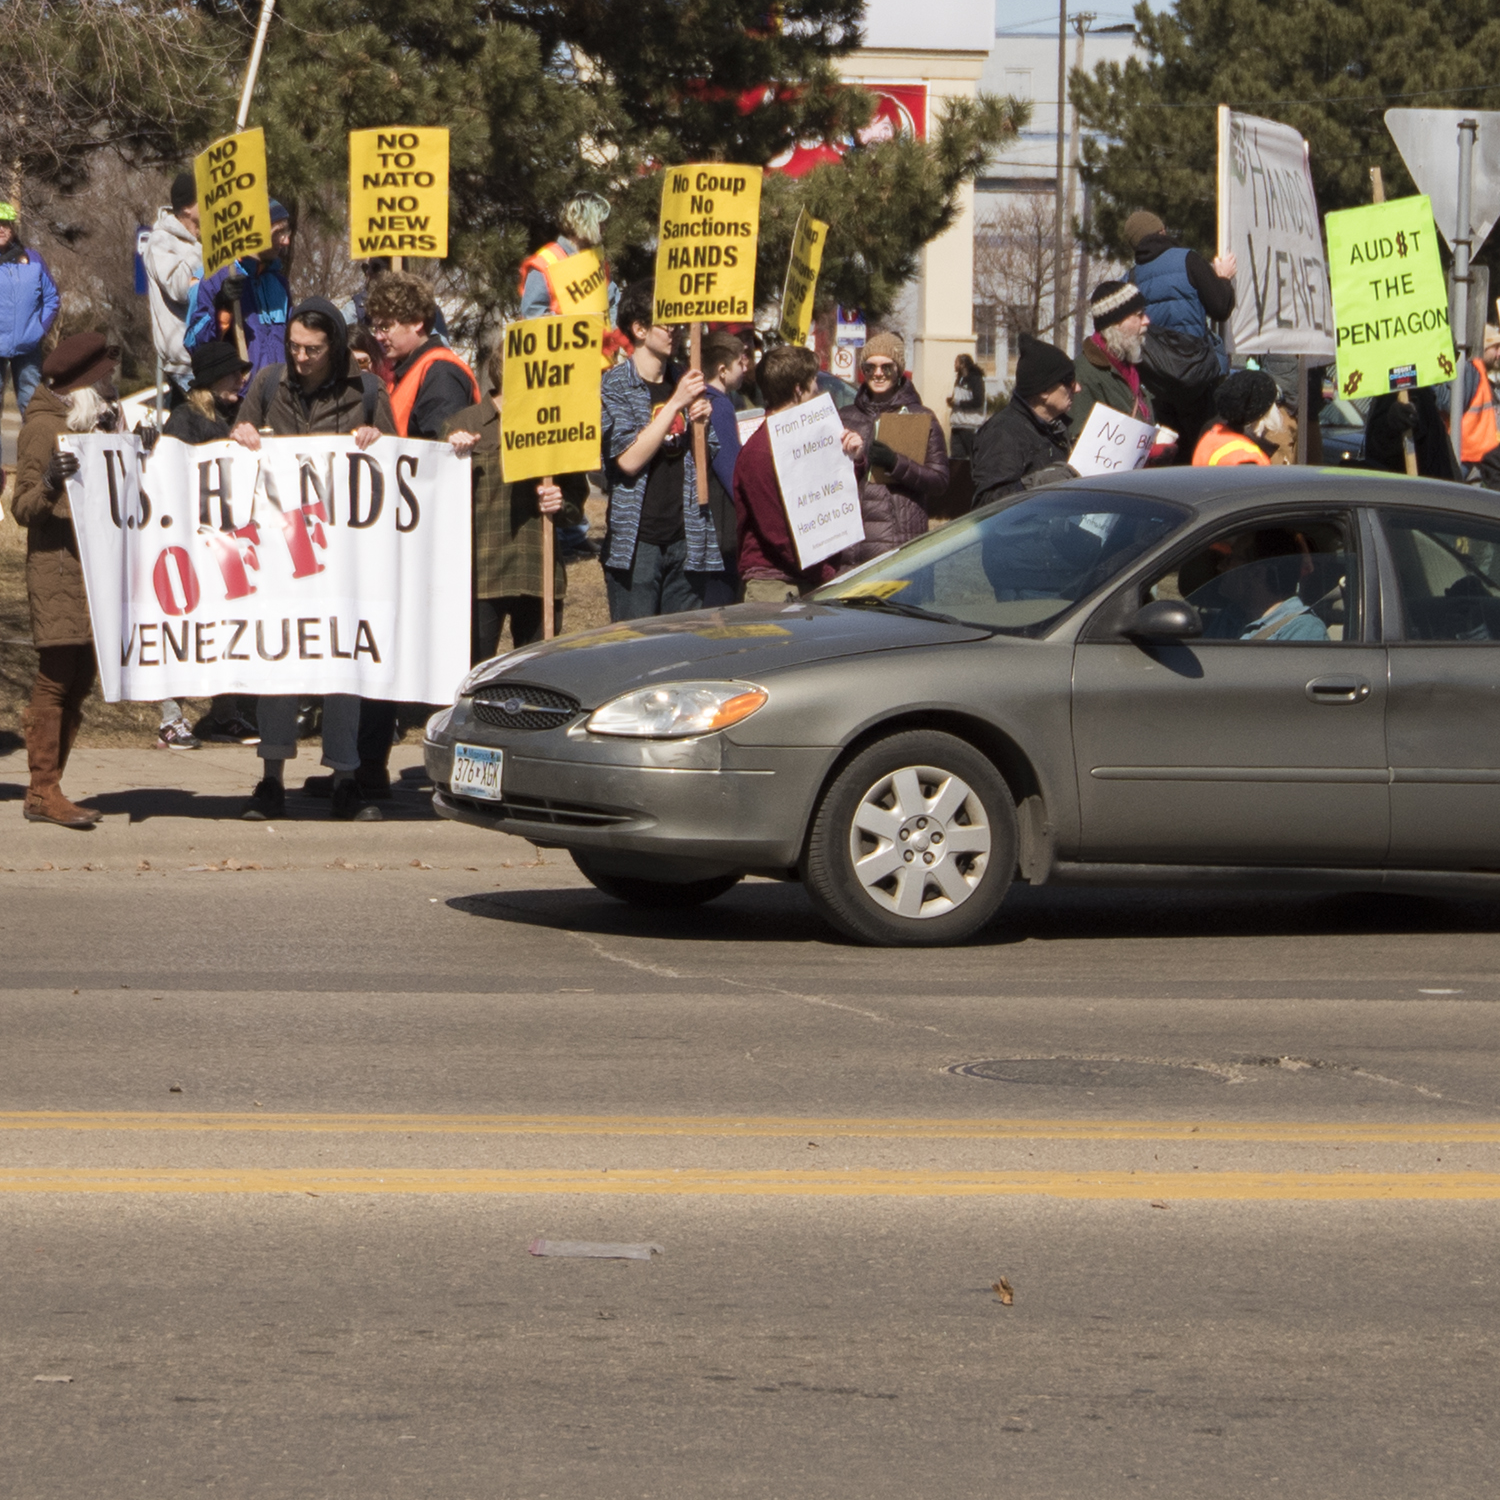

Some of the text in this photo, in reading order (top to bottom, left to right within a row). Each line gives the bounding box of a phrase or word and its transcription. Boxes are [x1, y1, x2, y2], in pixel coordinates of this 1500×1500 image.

[208, 140, 238, 167] NO
[377, 133, 420, 151] NO
[209, 159, 236, 184] TO
[377, 152, 416, 169] TO
[204, 172, 256, 211] NATO
[362, 171, 436, 190] NATO
[672, 172, 746, 197] No Coup
[213, 200, 243, 228] NO
[376, 195, 419, 213] NO
[690, 195, 714, 215] No
[211, 215, 255, 250] NEW
[368, 215, 431, 233] NEW
[663, 217, 752, 240] Sanctions
[207, 232, 264, 272] WARS
[358, 234, 438, 253] WARS
[667, 245, 738, 270] HANDS
[679, 272, 718, 296] OFF
[1369, 273, 1415, 301] THE
[656, 296, 748, 320] Venezuela
[507, 328, 537, 359] No
[547, 320, 598, 352] U.S.
[1336, 306, 1450, 348] PENTAGON
[524, 360, 575, 390] War
[536, 405, 561, 425] on
[774, 404, 836, 437] From Palestine
[504, 422, 596, 451] Venezuela
[1097, 421, 1126, 445] No
[792, 434, 834, 460] to Mexico
[1094, 445, 1122, 470] for
[103, 449, 421, 534] U.S. HANDS
[797, 479, 844, 509] All the Walls
[797, 502, 855, 536] Have Got to Go
[152, 501, 329, 617] OFF
[121, 615, 383, 668] VENEZUELA
